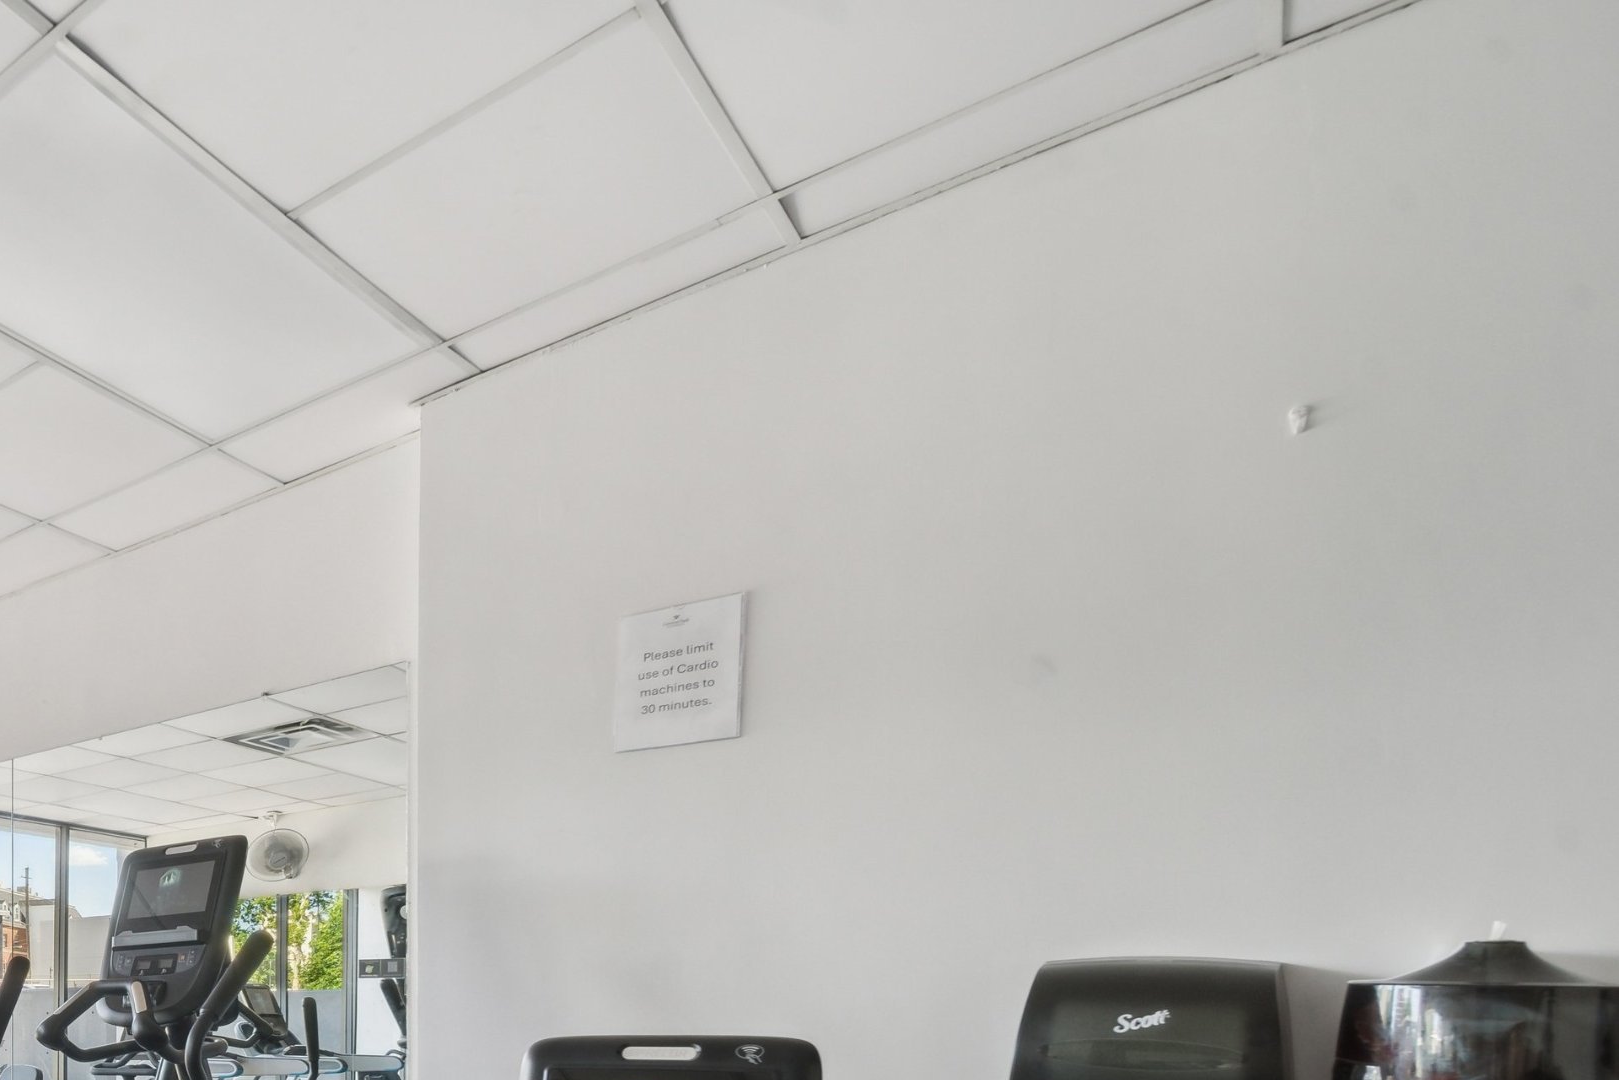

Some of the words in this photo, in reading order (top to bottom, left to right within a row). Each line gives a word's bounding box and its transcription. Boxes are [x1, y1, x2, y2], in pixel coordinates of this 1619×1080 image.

[643, 646, 683, 662] Please
[686, 642, 714, 655] limit
[638, 668, 659, 681] use
[662, 665, 674, 677] of
[677, 659, 719, 674] Cardio
[640, 681, 699, 698] machines
[703, 678, 715, 689] to
[641, 704, 656, 715] 30
[658, 697, 713, 713] minutes.
[1113, 1009, 1171, 1033] Scott
